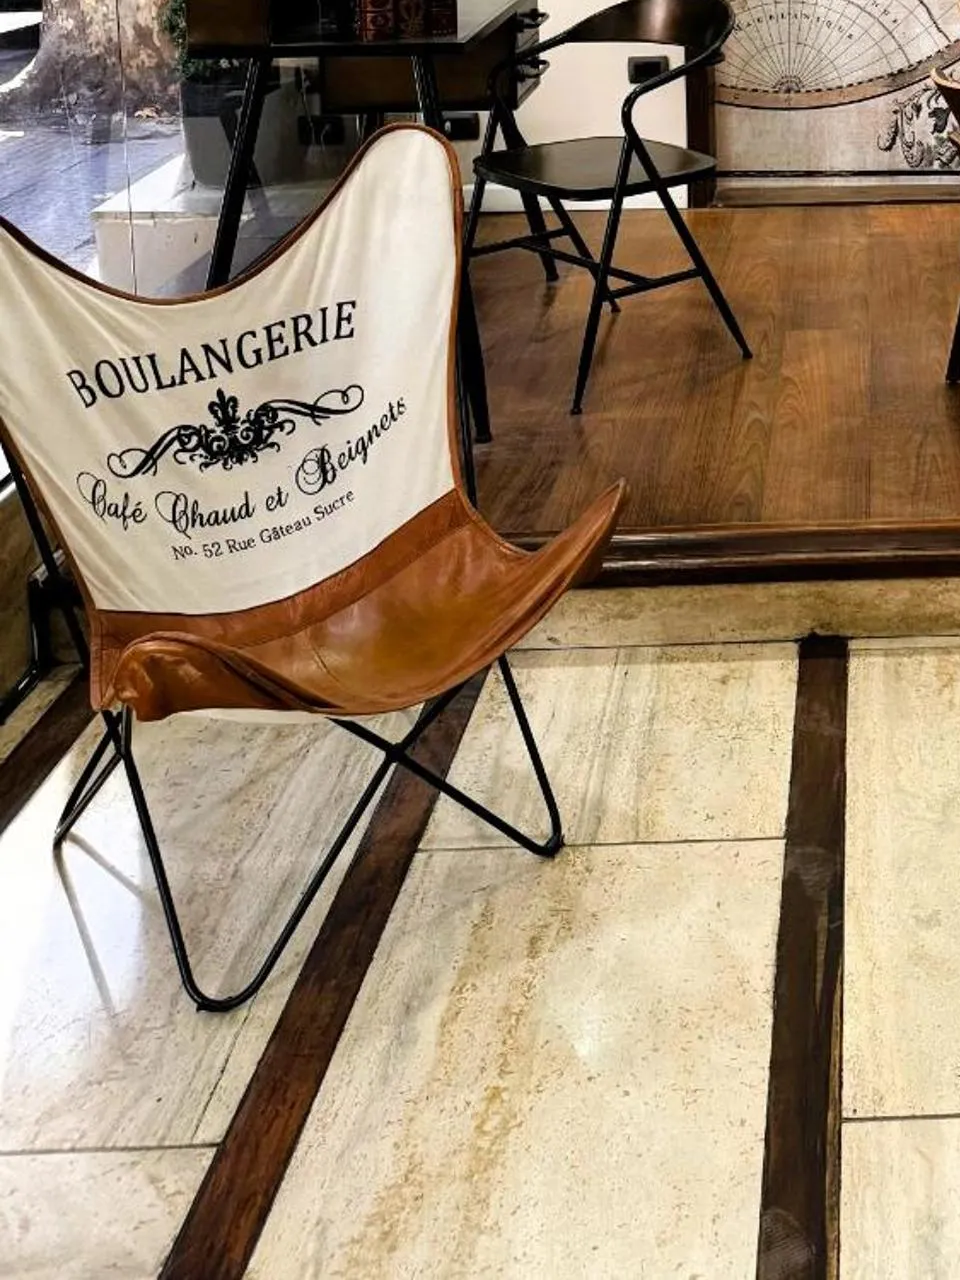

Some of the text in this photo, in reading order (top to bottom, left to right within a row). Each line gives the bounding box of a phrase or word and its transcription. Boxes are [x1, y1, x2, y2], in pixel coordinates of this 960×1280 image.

[66, 300, 357, 409] BOULANGERIE
[76, 397, 407, 540] Café Chaud et Beignets
[172, 489, 356, 561] No. 52 Rue Gâteau Sucre
